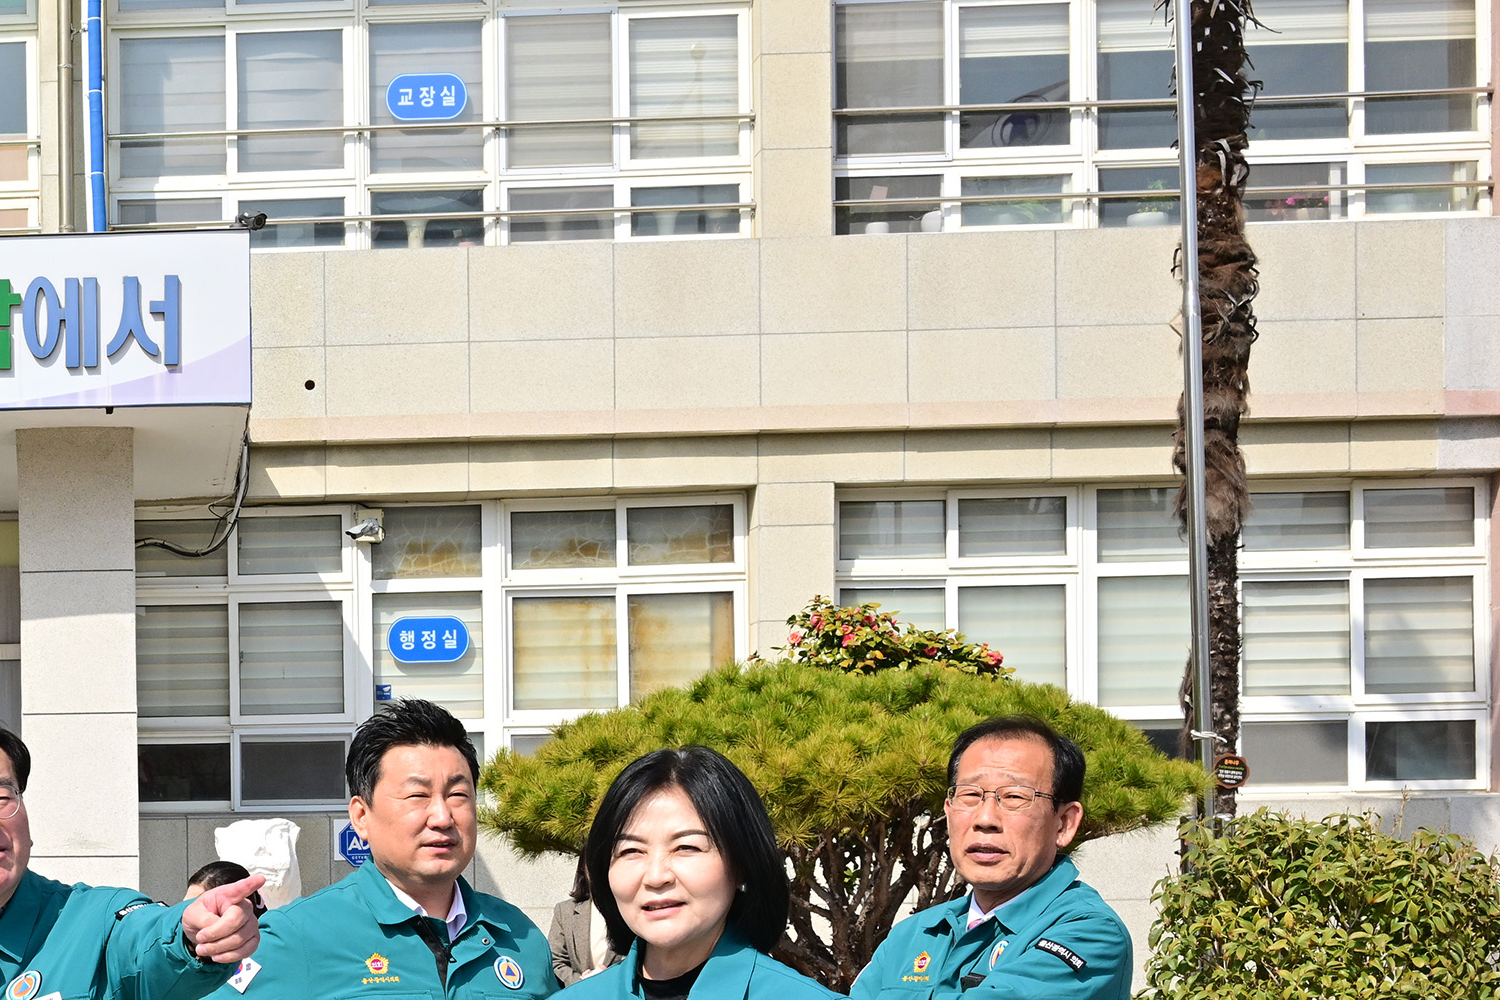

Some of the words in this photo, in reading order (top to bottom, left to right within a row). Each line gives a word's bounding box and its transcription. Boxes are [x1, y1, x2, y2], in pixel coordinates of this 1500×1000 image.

[397, 85, 456, 107] 교장실
[399, 629, 458, 650] 행정실
[348, 836, 370, 850] AD
